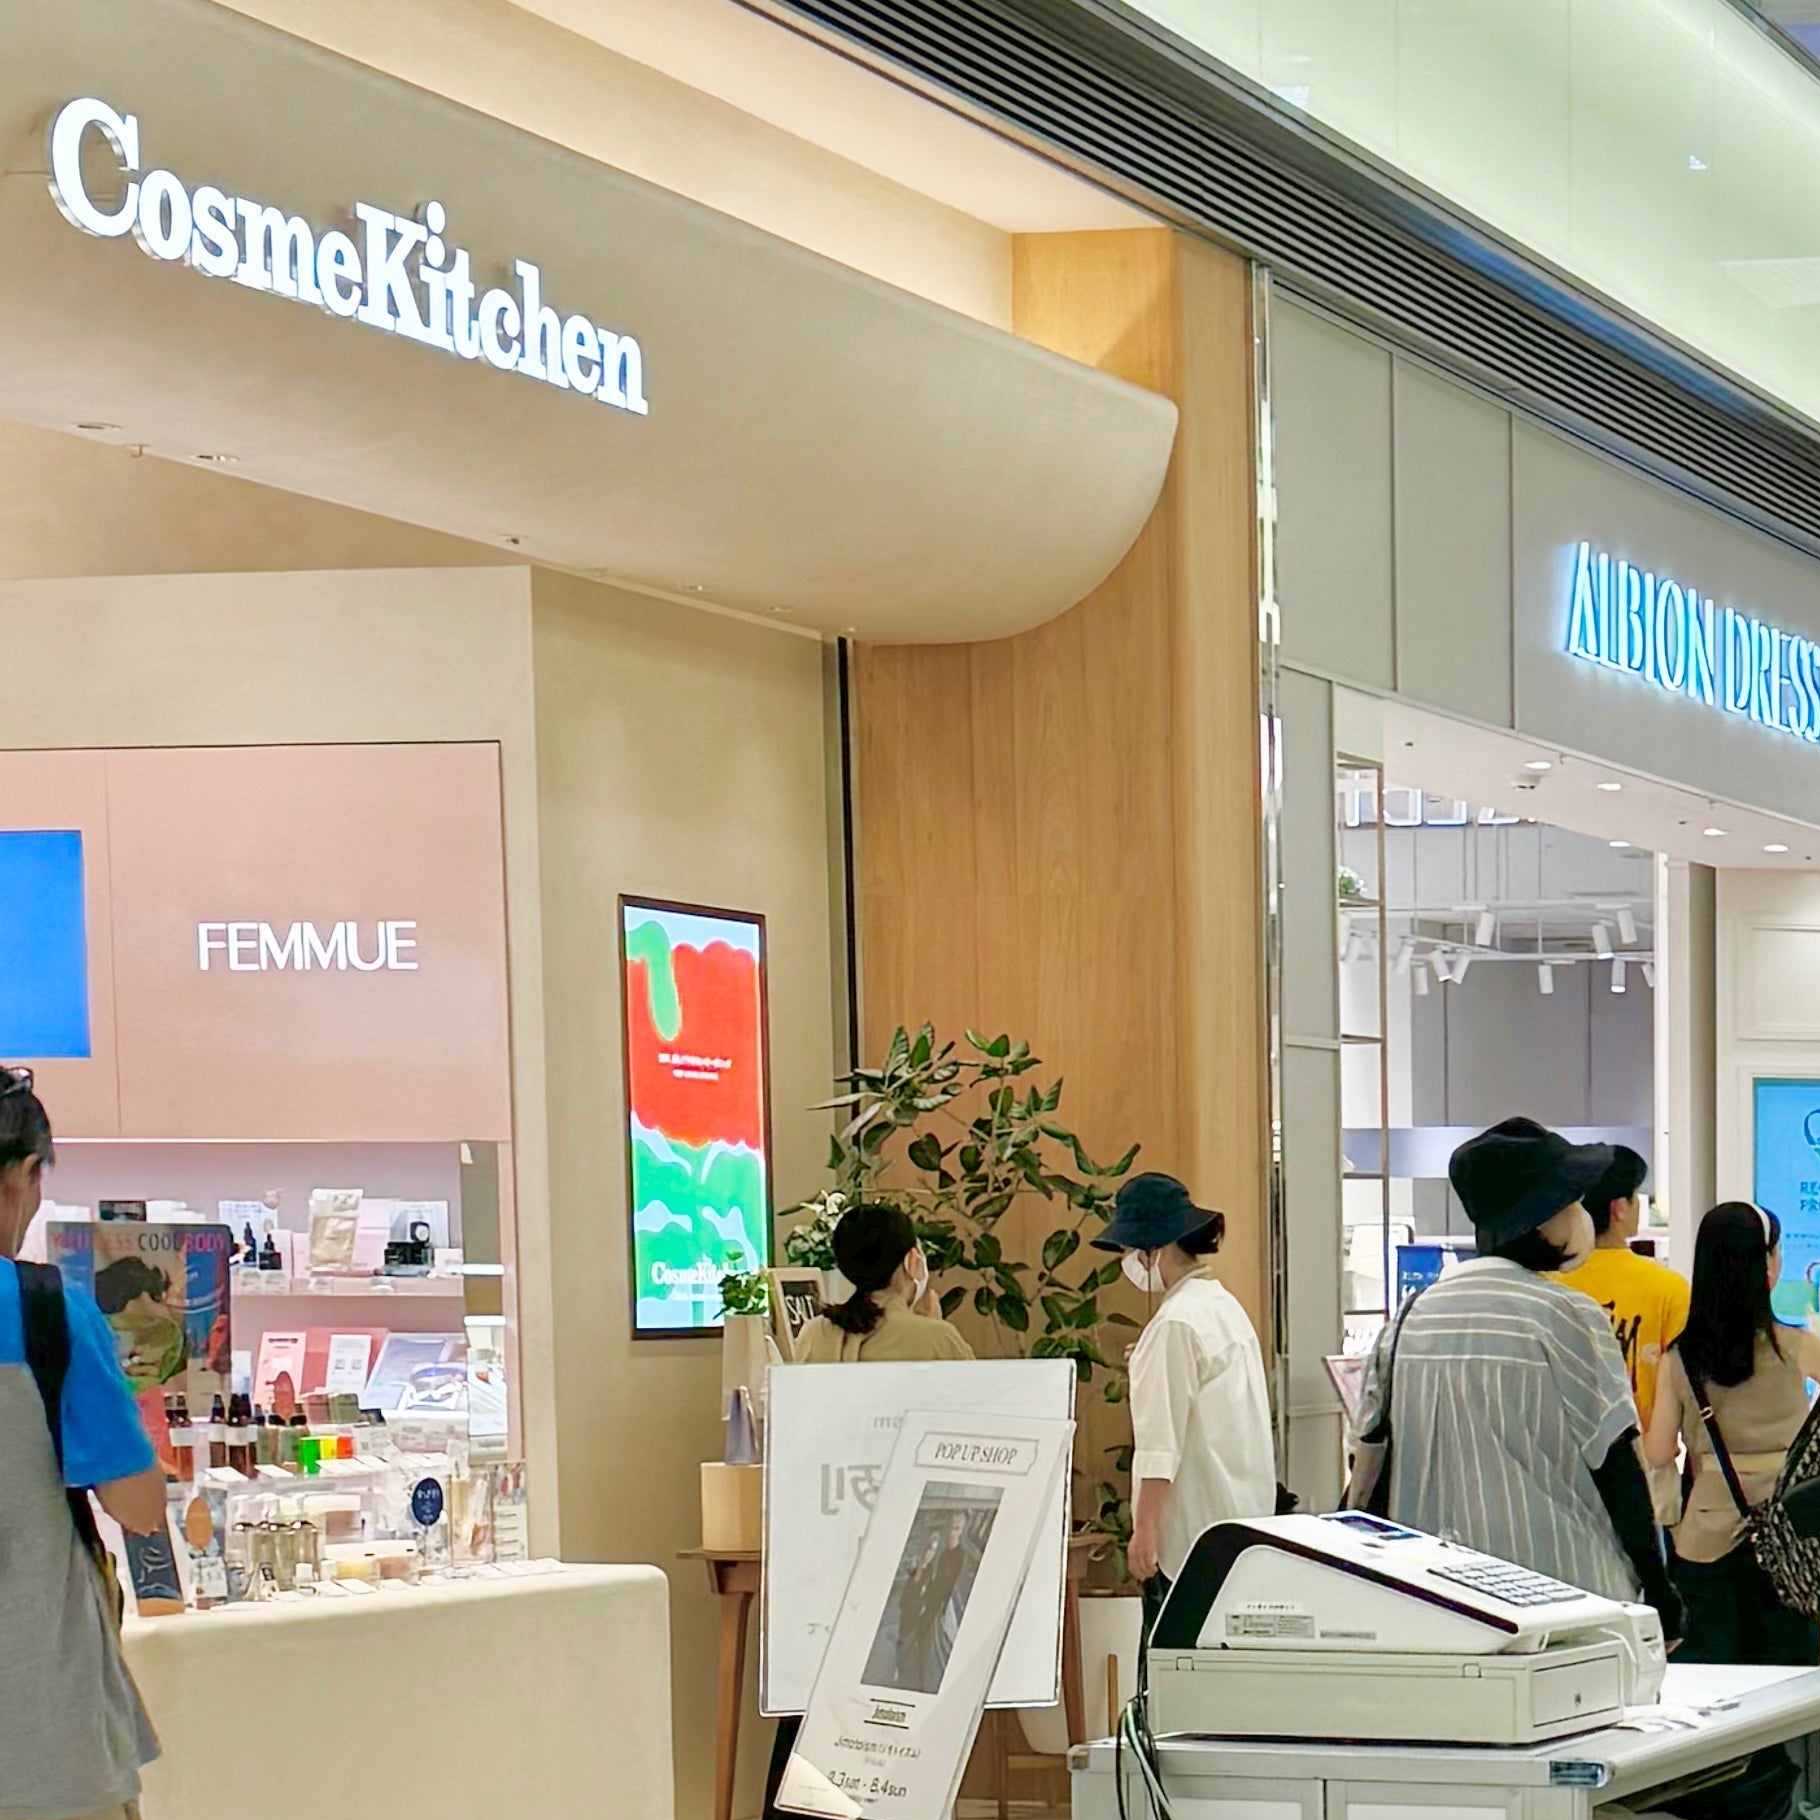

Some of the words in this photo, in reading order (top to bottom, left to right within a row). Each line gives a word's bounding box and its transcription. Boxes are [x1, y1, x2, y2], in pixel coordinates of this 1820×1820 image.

[49, 97, 649, 416] CosmeKitchen
[1567, 541, 1715, 706] ALBION
[198, 921, 419, 972] FEMMUE
[138, 1232, 179, 1251] COOL
[184, 1233, 226, 1251] BODY
[935, 1443, 961, 1460] POP
[962, 1446, 981, 1462] UP
[982, 1447, 1018, 1465] SHOP
